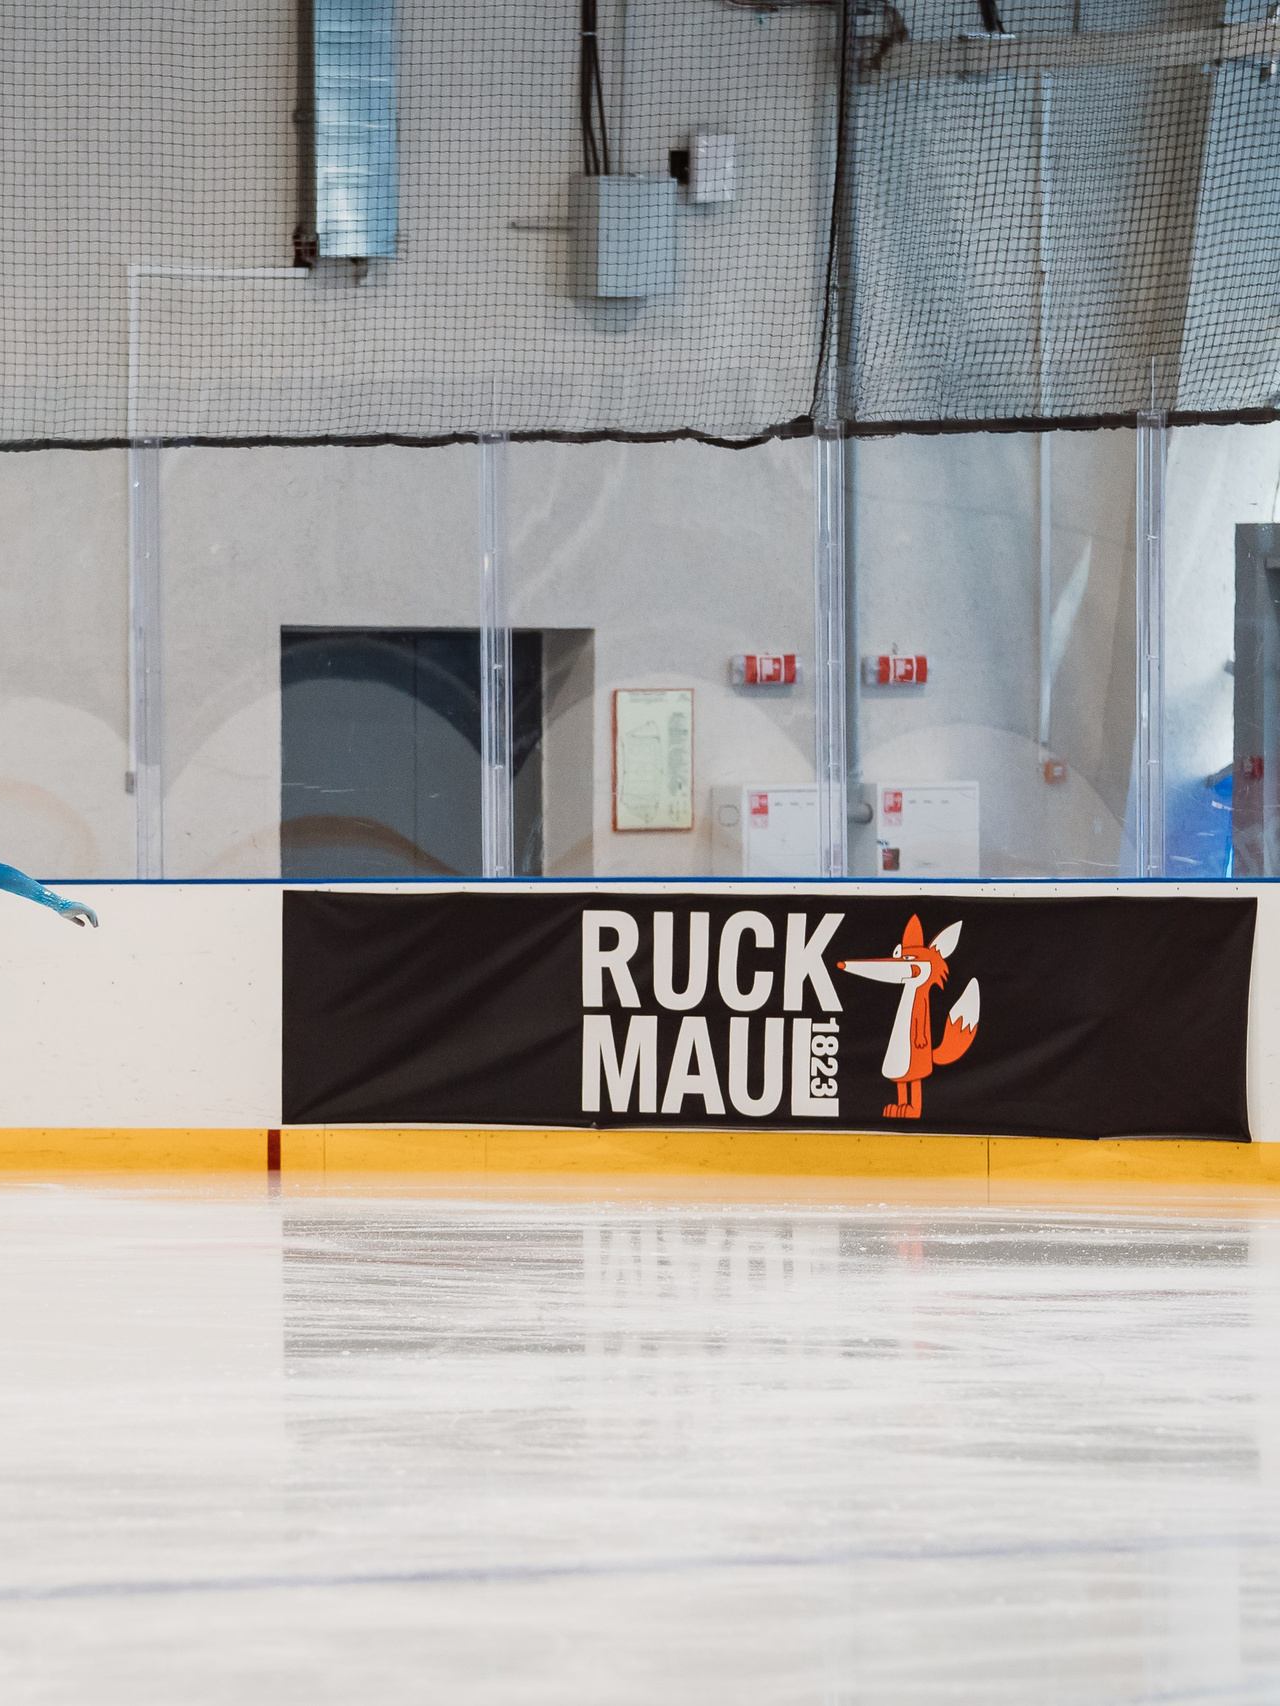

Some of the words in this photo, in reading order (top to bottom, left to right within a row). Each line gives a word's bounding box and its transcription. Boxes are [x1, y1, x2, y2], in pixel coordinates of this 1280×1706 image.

[582, 910, 845, 1012] RUCK
[581, 1014, 839, 1117] MAUL
[811, 1017, 839, 1099] 1823
